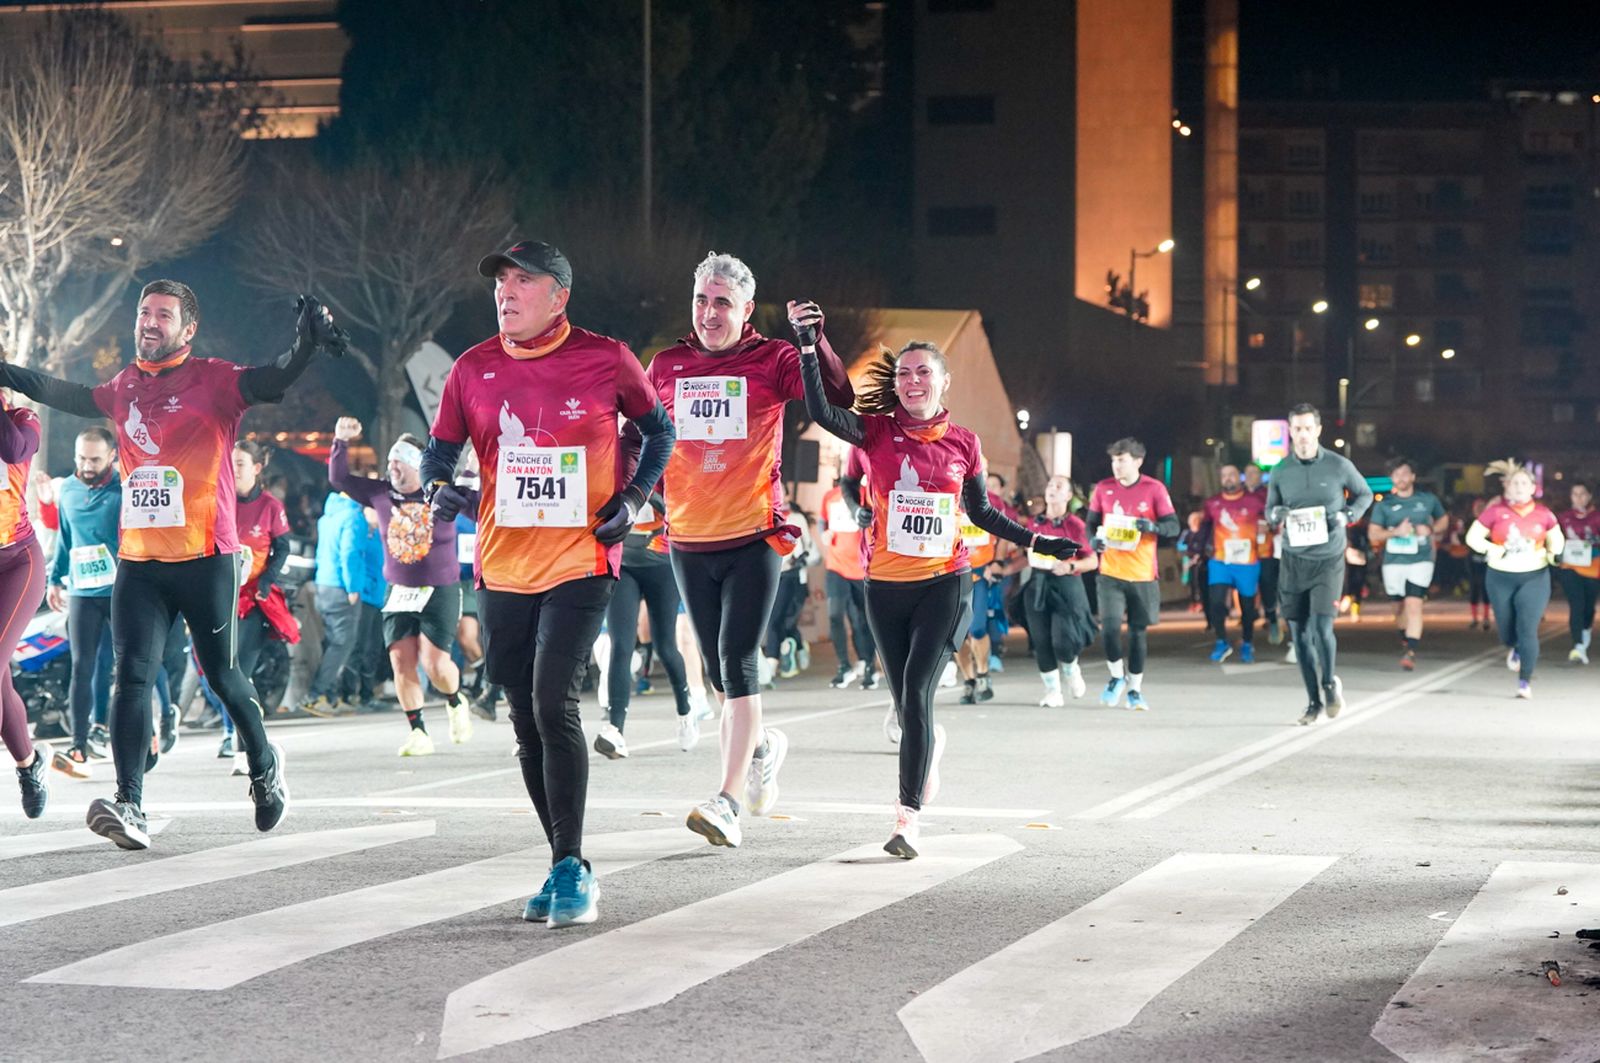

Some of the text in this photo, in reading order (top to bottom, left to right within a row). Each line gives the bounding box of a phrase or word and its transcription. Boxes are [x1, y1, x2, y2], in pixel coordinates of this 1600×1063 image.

[682, 391, 697, 399] SAN
[690, 398, 730, 418] 4071
[133, 428, 147, 445] 43
[516, 456, 552, 464] NOCHE DE
[506, 465, 522, 474] SAN
[516, 477, 566, 500] 7541
[132, 488, 171, 507] 5235
[905, 498, 925, 506] NOCHE
[901, 515, 942, 535] 4070
